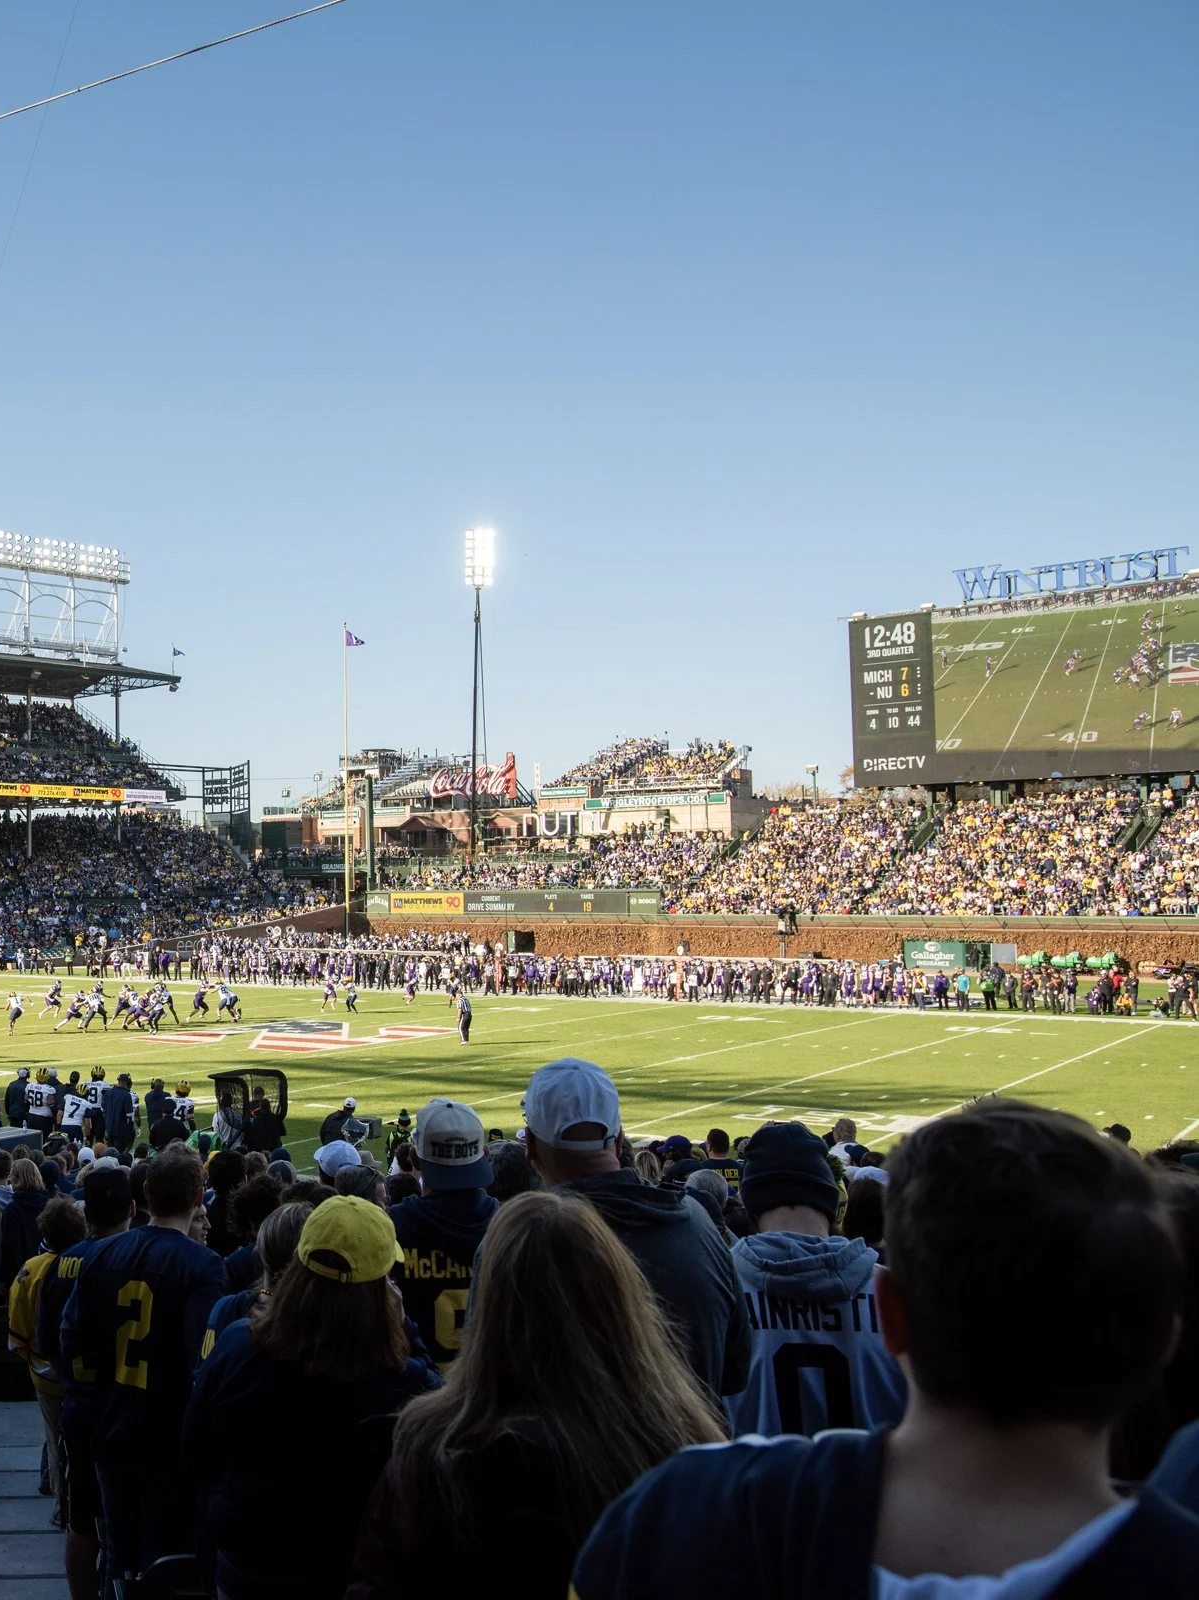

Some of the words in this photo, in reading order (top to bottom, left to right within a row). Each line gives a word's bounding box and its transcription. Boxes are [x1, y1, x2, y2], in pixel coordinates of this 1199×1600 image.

[952, 546, 1190, 601] WINTRUST
[864, 621, 916, 649] 12:48
[867, 649, 881, 659] 3RD
[882, 645, 914, 657] QUARTER
[864, 669, 893, 684] MICH
[901, 667, 909, 680] 7
[877, 685, 893, 699] NU
[901, 683, 909, 697] 6
[869, 718, 877, 730] 4
[888, 716, 899, 728] 10
[907, 715, 921, 727] 44
[1058, 731, 1098, 744] 40
[863, 755, 926, 772] DIRECTV
[19, 785, 30, 794] 90
[111, 788, 121, 798] 90
[446, 896, 460, 907] 90
[467, 903, 484, 911] DRIVE
[485, 903, 515, 912] SUMMARY
[548, 902, 554, 912] 4
[583, 902, 592, 912] 19
[911, 951, 955, 960] Gallagher
[68, 1101, 81, 1118] 7
[430, 1141, 453, 1159] THE
[454, 1139, 479, 1159] BOYS
[114, 1279, 154, 1390] 2
